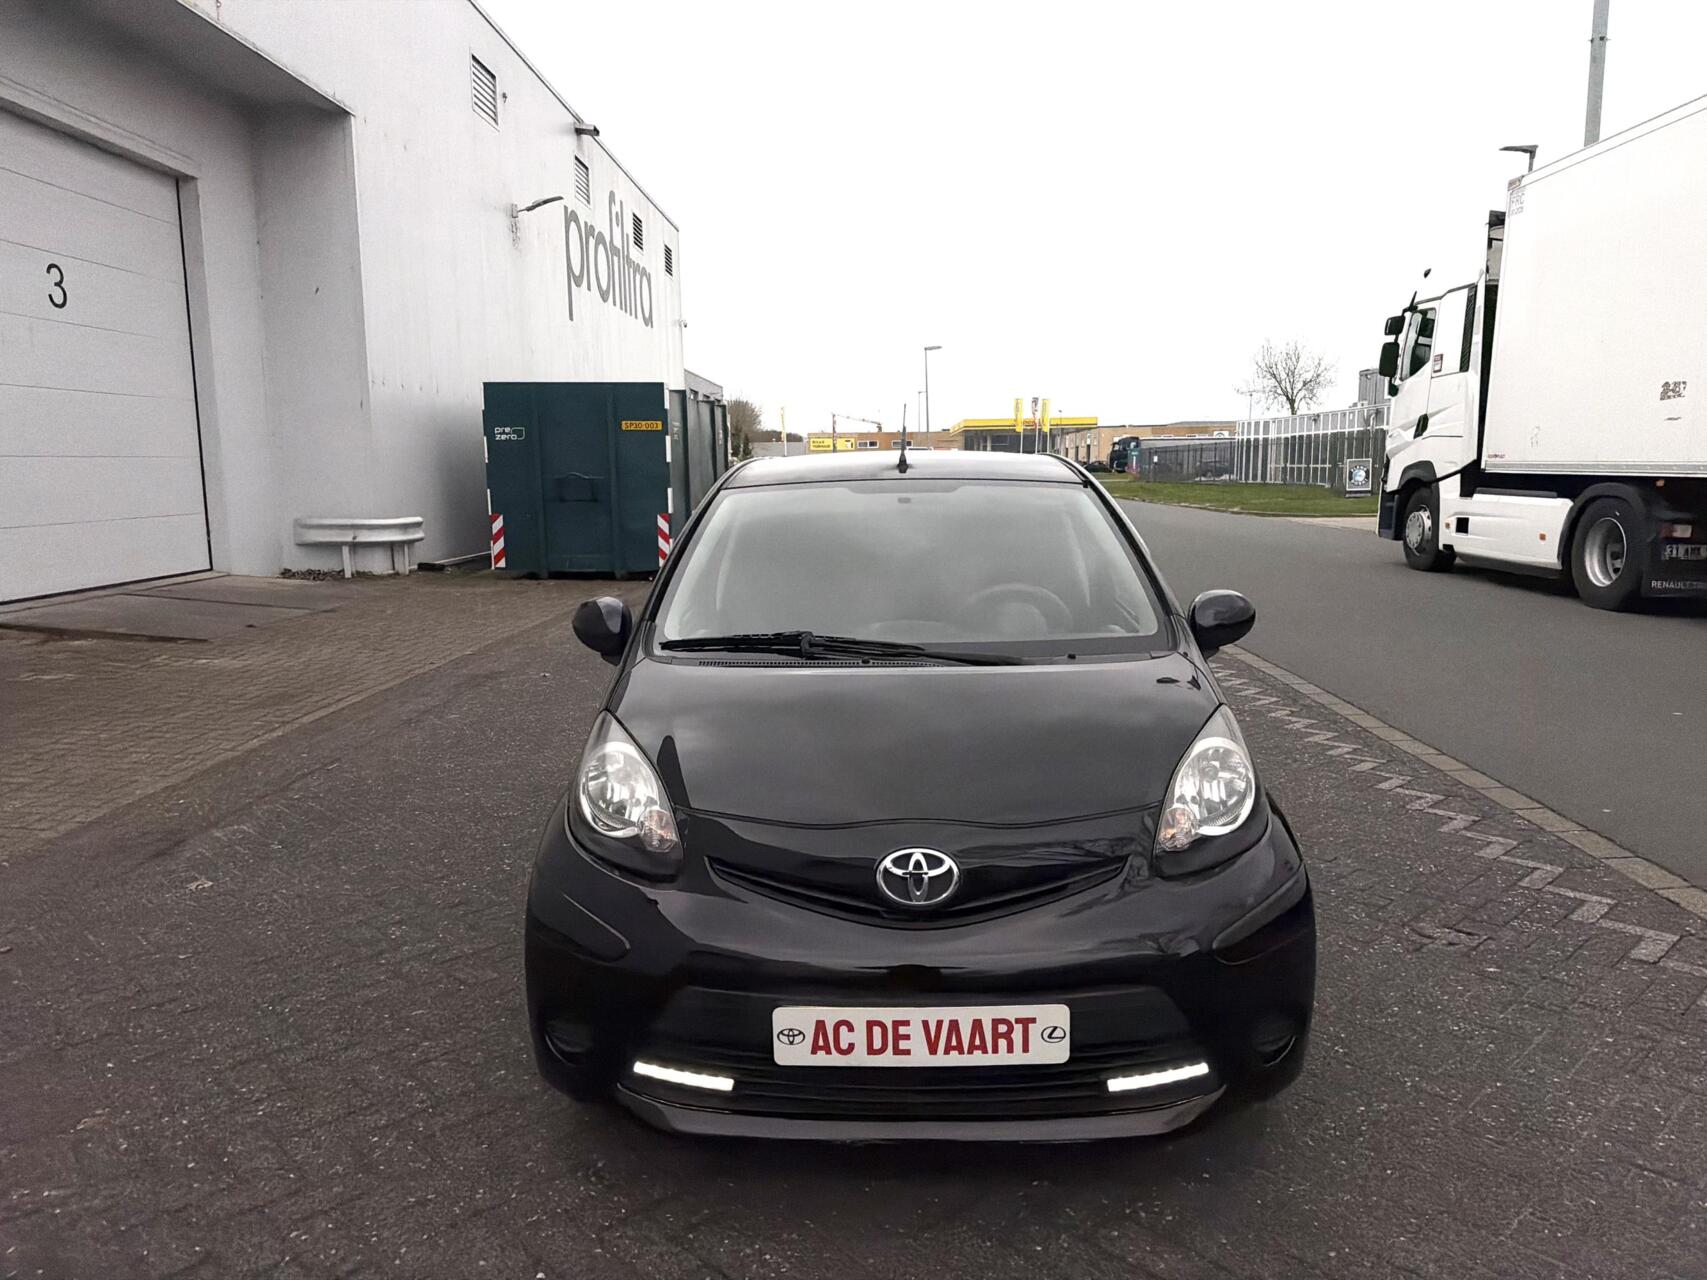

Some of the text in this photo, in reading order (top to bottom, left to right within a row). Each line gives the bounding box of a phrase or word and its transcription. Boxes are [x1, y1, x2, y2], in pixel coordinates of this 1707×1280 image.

[564, 190, 653, 328] profiltra
[46, 263, 67, 309] 3
[810, 1017, 1037, 1056] AC DE VAART
